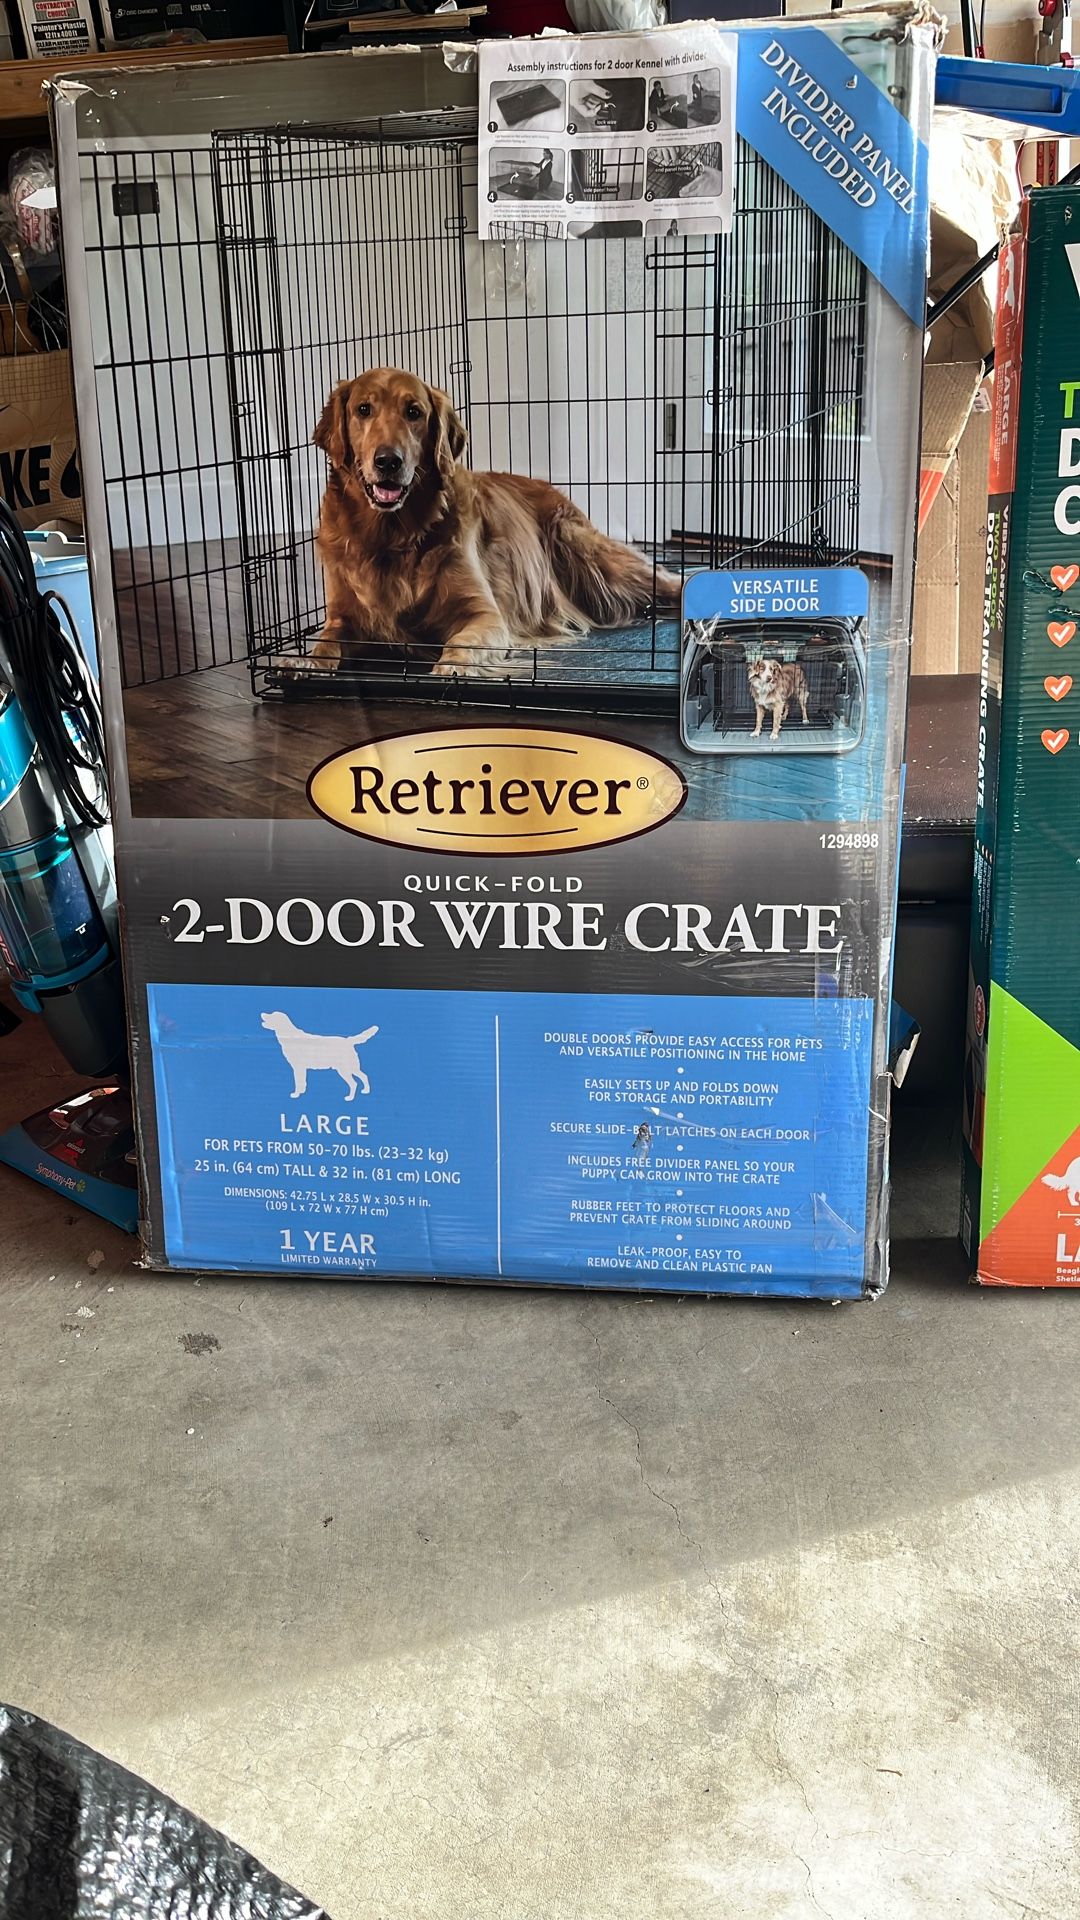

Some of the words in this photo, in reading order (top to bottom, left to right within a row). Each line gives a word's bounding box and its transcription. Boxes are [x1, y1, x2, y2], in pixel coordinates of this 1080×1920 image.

[33, 24, 62, 32] Painter's
[63, 22, 86, 30] Plastic
[507, 61, 546, 74] Assembly
[547, 60, 592, 71] instructions
[594, 59, 606, 70] for
[607, 60, 613, 69] 2
[615, 59, 633, 69] door
[635, 57, 663, 68] Kennel
[665, 54, 680, 66] with
[759, 40, 857, 144] DIVIDER
[850, 133, 918, 215] PANEL
[760, 86, 878, 210] INCLUDED
[1001, 360, 1012, 445] LARGE
[985, 512, 995, 575] DOG
[733, 579, 819, 594] VERSATILE
[730, 599, 765, 613] SIDE
[772, 597, 820, 612] DOOR
[990, 567, 998, 629] DOOR
[979, 583, 992, 718] TRAINING
[977, 725, 987, 809] CRATE
[818, 833, 880, 850] 1294898
[404, 875, 583, 893] QUICK-FOLD
[172, 896, 424, 949] 2-DOOR
[430, 901, 607, 951] WIRE
[624, 902, 845, 955] CRATE
[544, 1032, 588, 1044] DOUBLE
[592, 1033, 631, 1045] DOORS
[635, 1034, 684, 1046] PROVIDE
[689, 1036, 716, 1047] EASY
[721, 1037, 763, 1048] ACCESS
[768, 1038, 790, 1048] FOR
[795, 1038, 823, 1049] PETS
[559, 1046, 584, 1056] AND
[588, 1046, 646, 1058] VERSATILE
[651, 1048, 724, 1060] POSITIONING
[729, 1050, 740, 1060] IN
[744, 1050, 767, 1061] THE
[771, 1051, 806, 1062] HOME
[584, 1078, 621, 1090] EASILY
[626, 1079, 651, 1091] SETS
[656, 1080, 670, 1092] UP
[674, 1081, 698, 1092] AND
[703, 1082, 739, 1092] FOLDS
[743, 1083, 778, 1094] DOWN
[589, 1091, 611, 1102] FOR
[615, 1092, 666, 1104] STORAGE
[671, 1093, 695, 1104] AND
[699, 1094, 774, 1107] PORTABILITY
[280, 1114, 369, 1136] LARGE
[550, 1122, 591, 1134] SECURE
[595, 1123, 662, 1136] SLIDE-BLT
[666, 1126, 716, 1137] LATCHES
[720, 1127, 737, 1138] ON
[741, 1128, 771, 1139] EACH
[776, 1129, 810, 1140] DOOR
[204, 1139, 228, 1151] FOR
[234, 1140, 263, 1152] PETS
[267, 1142, 303, 1154] FROM
[352, 1145, 374, 1158] lbs.
[428, 1148, 448, 1163] kg)
[194, 1160, 209, 1171] 25
[214, 1161, 228, 1172] in.
[232, 1161, 252, 1174] (64
[257, 1162, 280, 1176] cm)
[283, 1164, 314, 1177] TALL
[319, 1166, 328, 1178] &
[333, 1167, 347, 1178] 32
[352, 1168, 367, 1180] in.
[372, 1168, 392, 1181] (81
[397, 1170, 420, 1183] cm)
[424, 1171, 460, 1184] LONG
[568, 1155, 621, 1167] INCLUDES
[625, 1156, 651, 1168] FREE
[655, 1158, 700, 1169] DIVIDER
[705, 1159, 740, 1171] PANEL
[744, 1161, 759, 1171] SO
[763, 1161, 795, 1173] YOUR
[582, 1168, 616, 1180] PUPPY
[620, 1169, 646, 1180] CAN
[647, 1170, 680, 1181] GROW
[685, 1171, 712, 1182] INTO
[716, 1172, 739, 1183] THE
[743, 1173, 779, 1185] CRATE
[224, 1187, 288, 1199] DIMENSIONS:
[290, 1190, 317, 1201] 42.75
[321, 1192, 326, 1202] L
[338, 1192, 359, 1202] 28.5
[363, 1194, 372, 1203] W
[384, 1195, 404, 1205] 30.5
[409, 1197, 415, 1206] H
[419, 1197, 430, 1207] in.
[266, 1200, 288, 1212] (109
[291, 1202, 296, 1211] L
[308, 1203, 320, 1212] 72
[323, 1204, 332, 1213] W
[345, 1204, 356, 1214] 77
[360, 1206, 367, 1215] H
[371, 1206, 388, 1217] cm)
[571, 1200, 612, 1211] RUBBER
[616, 1201, 641, 1212] FEET
[645, 1202, 661, 1213] TO
[665, 1203, 715, 1215] PROTECT
[719, 1204, 761, 1216] FLOORS
[766, 1206, 790, 1217] AND
[570, 1212, 617, 1224] PREVENT
[621, 1213, 657, 1225] CRATE
[661, 1215, 691, 1226] FROM
[696, 1216, 739, 1228] SLIDING
[743, 1218, 791, 1230] AROUND
[280, 1229, 295, 1249] 1
[304, 1231, 376, 1254] YEAR
[281, 1254, 320, 1265] LIMITED
[323, 1255, 377, 1268] WARRANTY
[617, 1246, 691, 1259] LEAK-PROOF,
[695, 1249, 721, 1260] EASY
[726, 1250, 741, 1260] TO
[587, 1257, 631, 1268] REMOVE
[635, 1259, 658, 1270] AND
[663, 1260, 698, 1271] CLEAN
[702, 1261, 746, 1273] PLASTIC
[751, 1263, 772, 1274] PAN
[1056, 1267, 1080, 1275] Beagl
